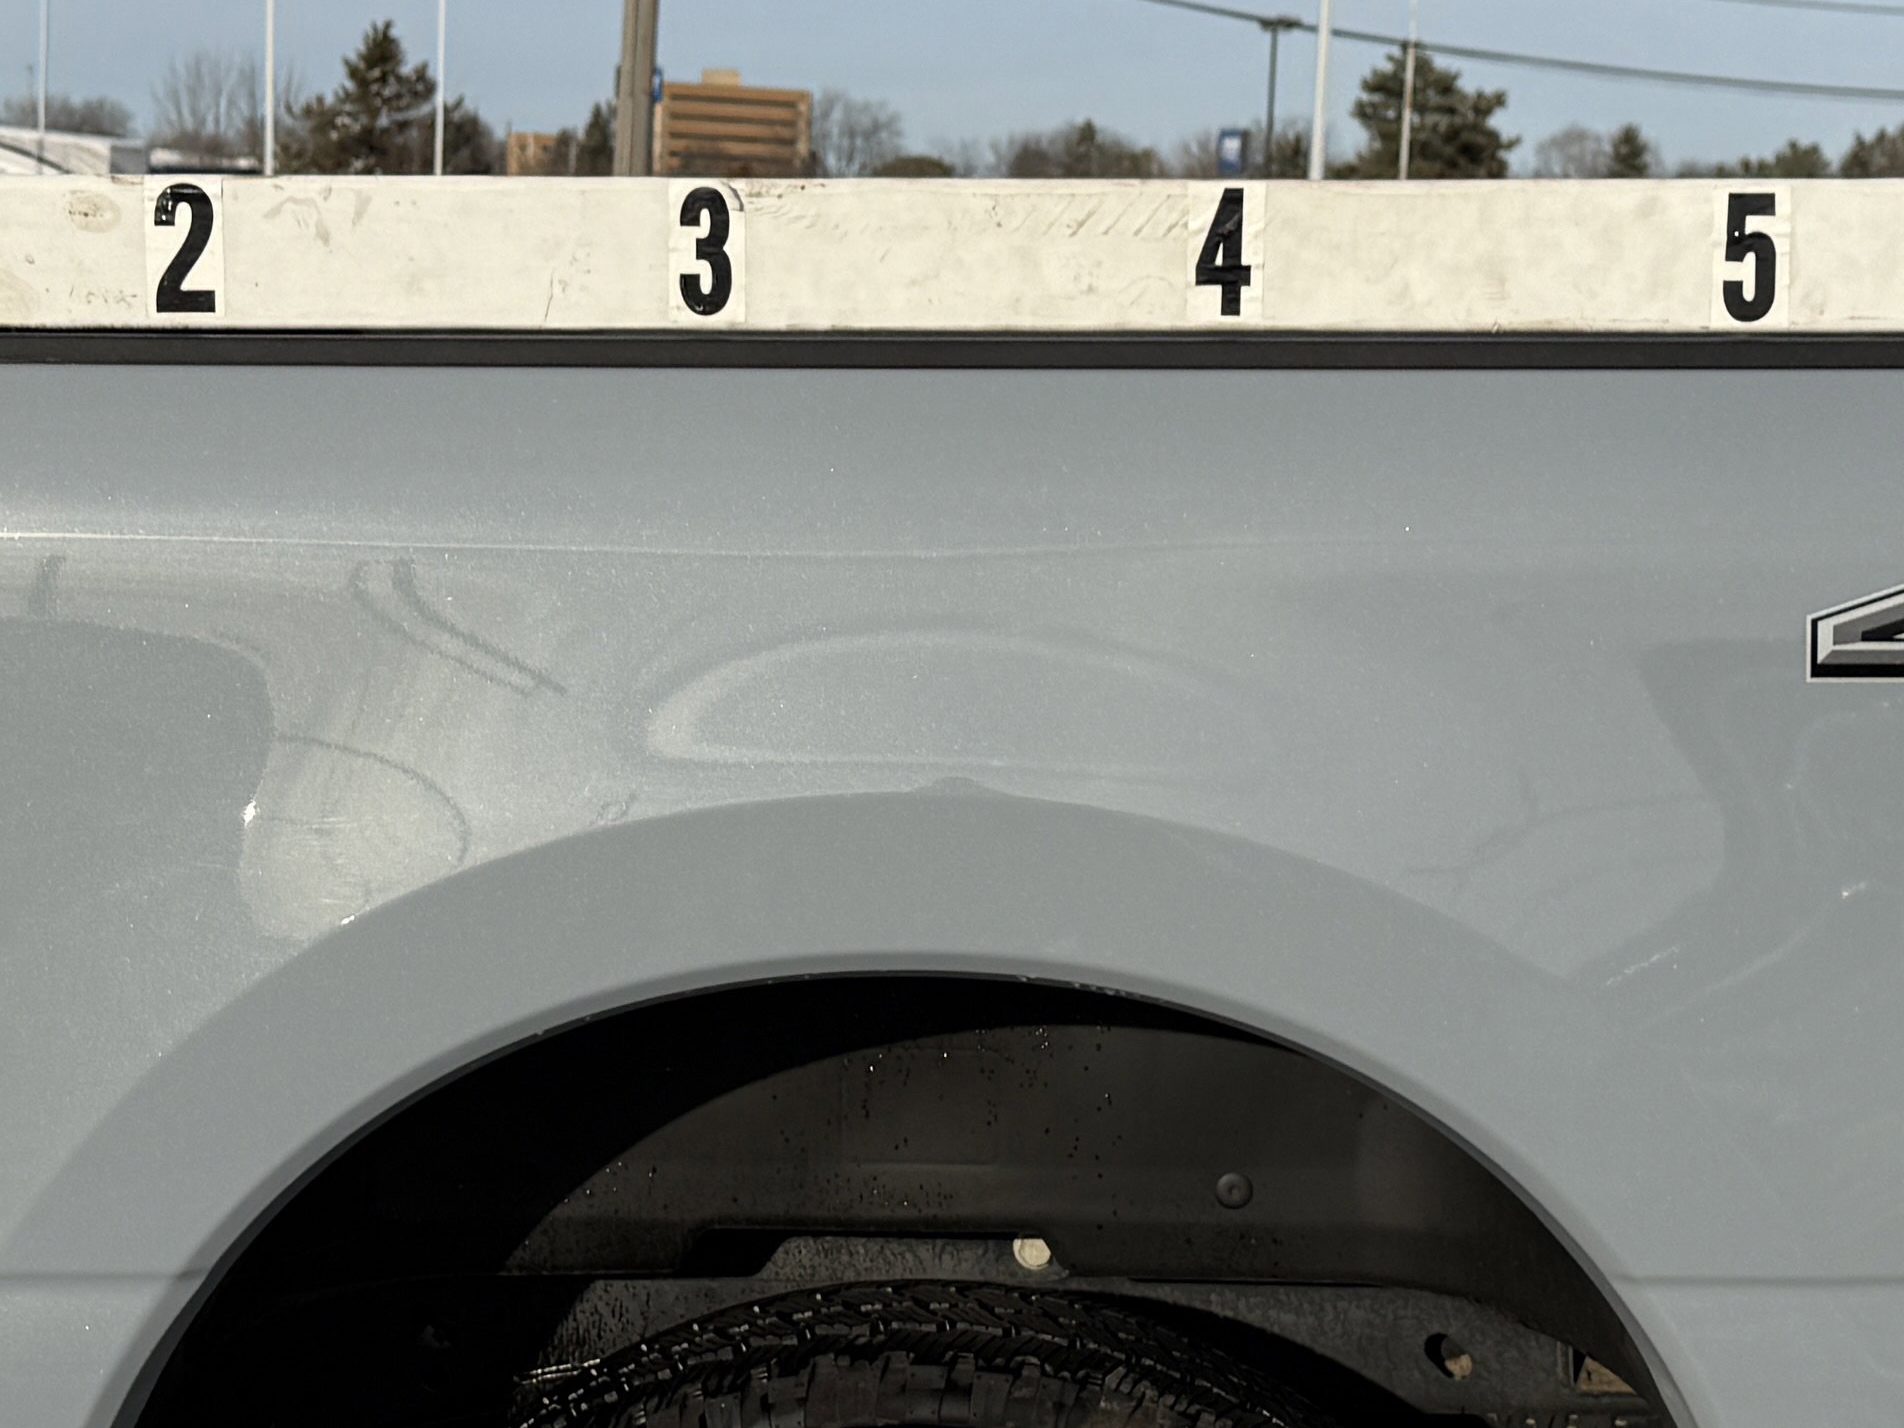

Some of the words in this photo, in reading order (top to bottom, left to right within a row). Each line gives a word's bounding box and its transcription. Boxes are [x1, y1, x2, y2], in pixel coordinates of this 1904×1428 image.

[153, 183, 217, 313] 2
[679, 187, 733, 316] 3
[1195, 187, 1253, 316] 4
[1722, 192, 1777, 322] 5
